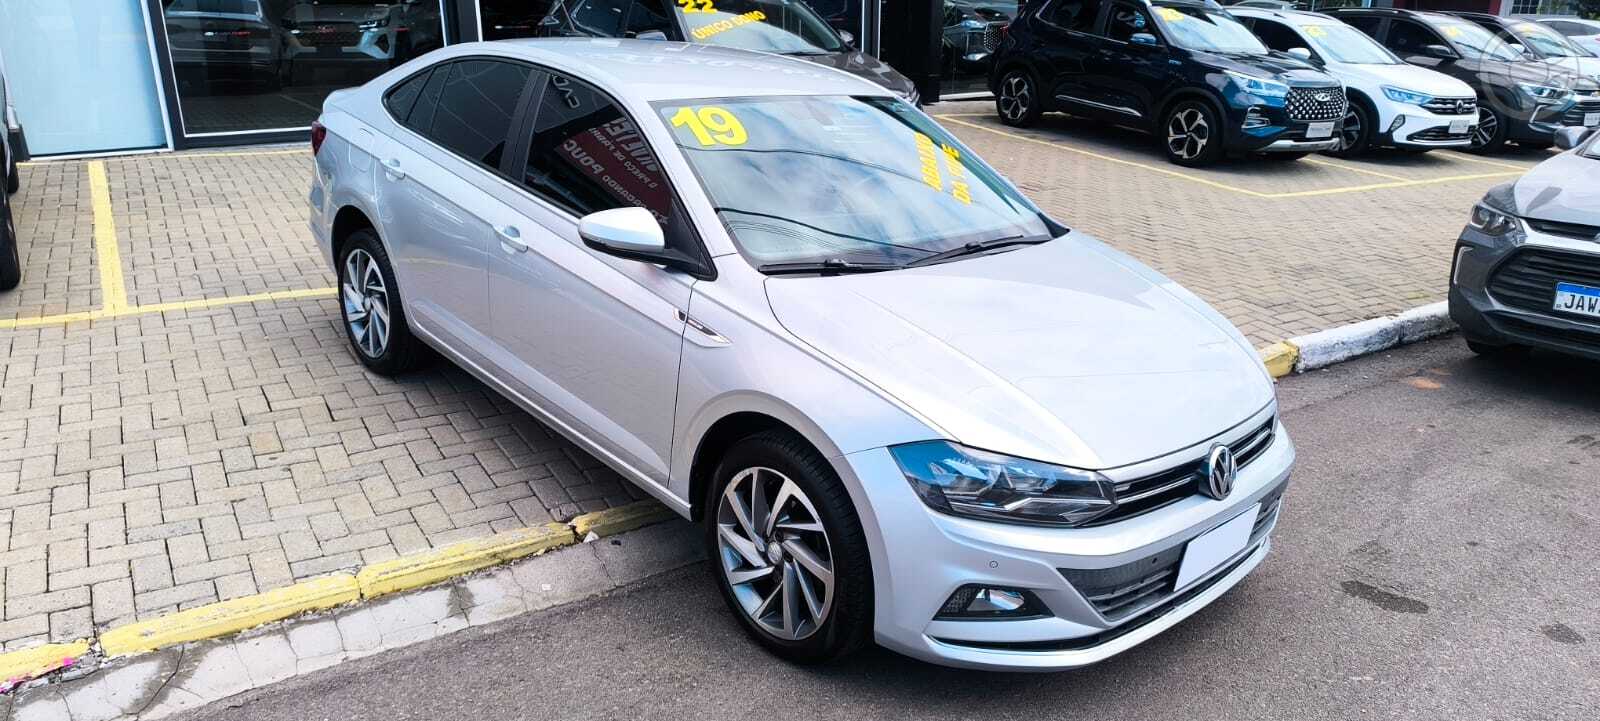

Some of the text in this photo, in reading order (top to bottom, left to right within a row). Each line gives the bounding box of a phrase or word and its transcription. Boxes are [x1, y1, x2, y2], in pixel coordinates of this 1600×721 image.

[678, 0, 718, 14] 22
[671, 106, 748, 146] 19
[1564, 294, 1600, 313] JAW
